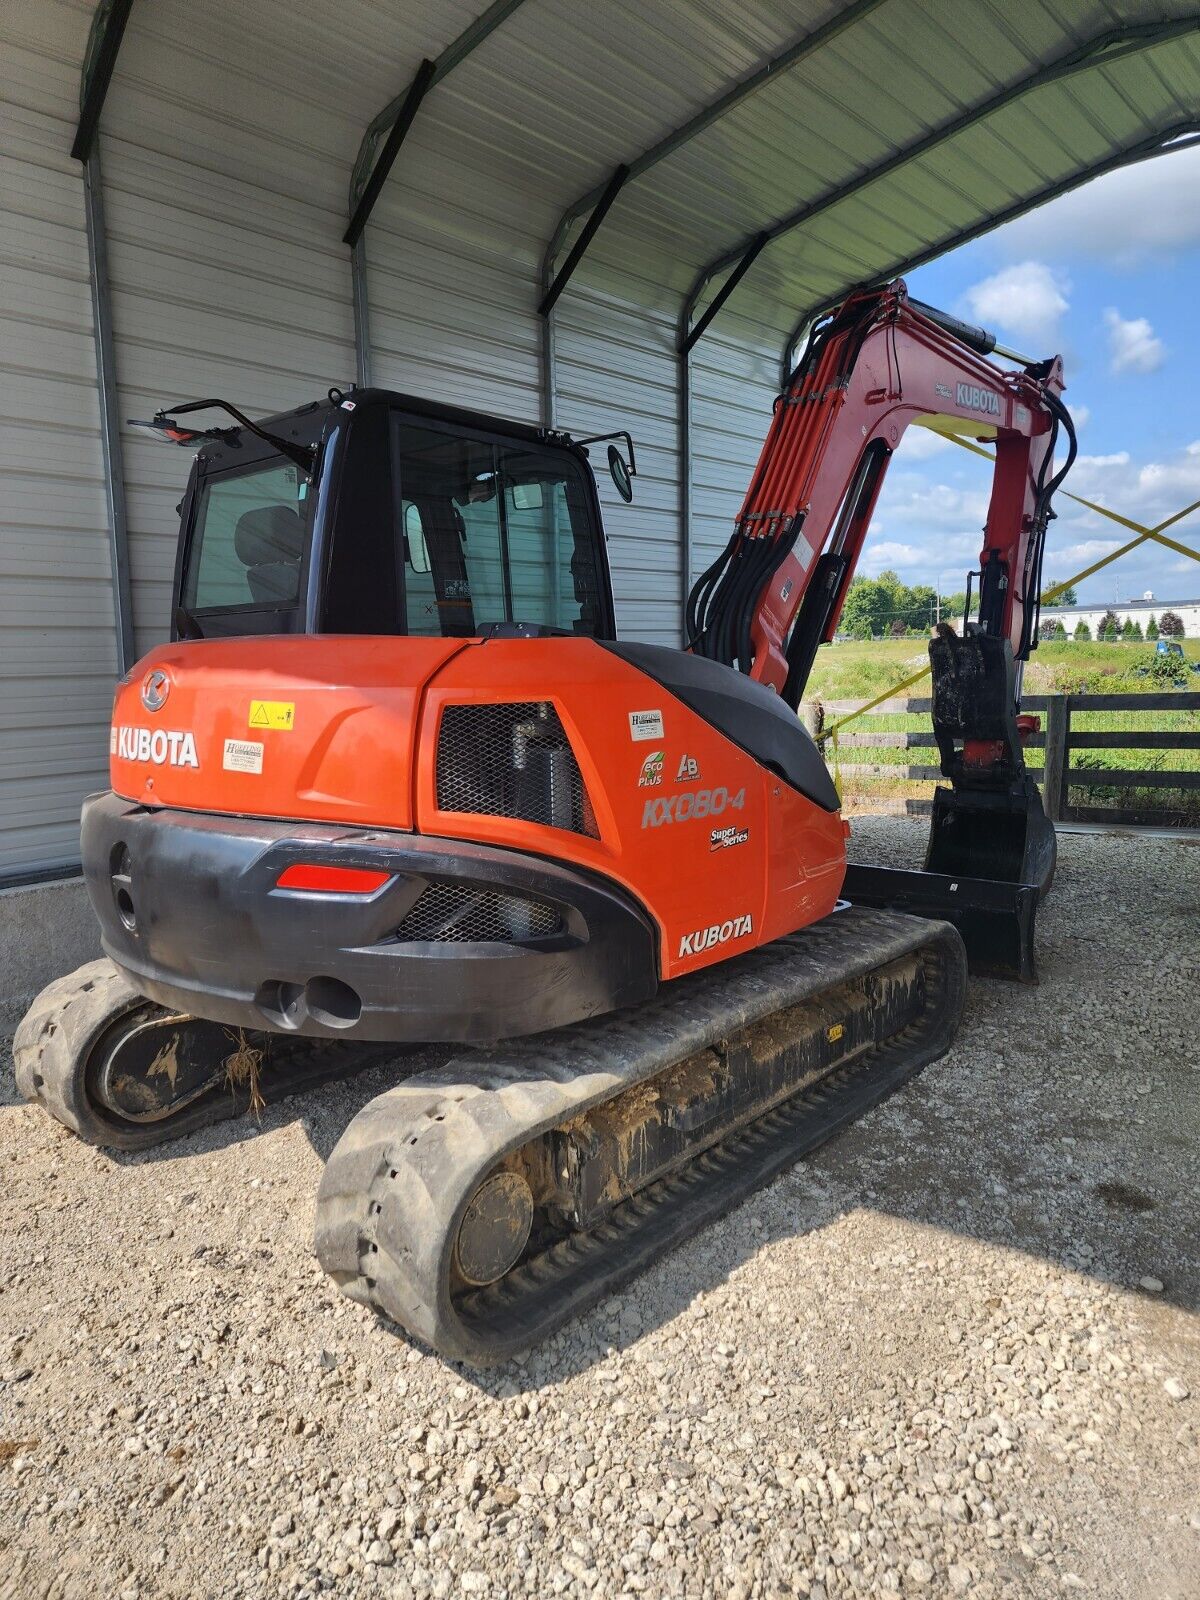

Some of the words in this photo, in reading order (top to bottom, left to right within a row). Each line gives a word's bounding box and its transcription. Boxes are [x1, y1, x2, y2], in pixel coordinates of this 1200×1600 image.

[957, 383, 1000, 413] KUBOTA
[118, 727, 200, 768] KUBOTA
[644, 761, 663, 772] eco
[638, 776, 662, 787] PLUS
[641, 787, 746, 829] KX080-4
[710, 826, 736, 842] Super
[723, 832, 749, 847] Series
[678, 914, 753, 958] KUBOTA
